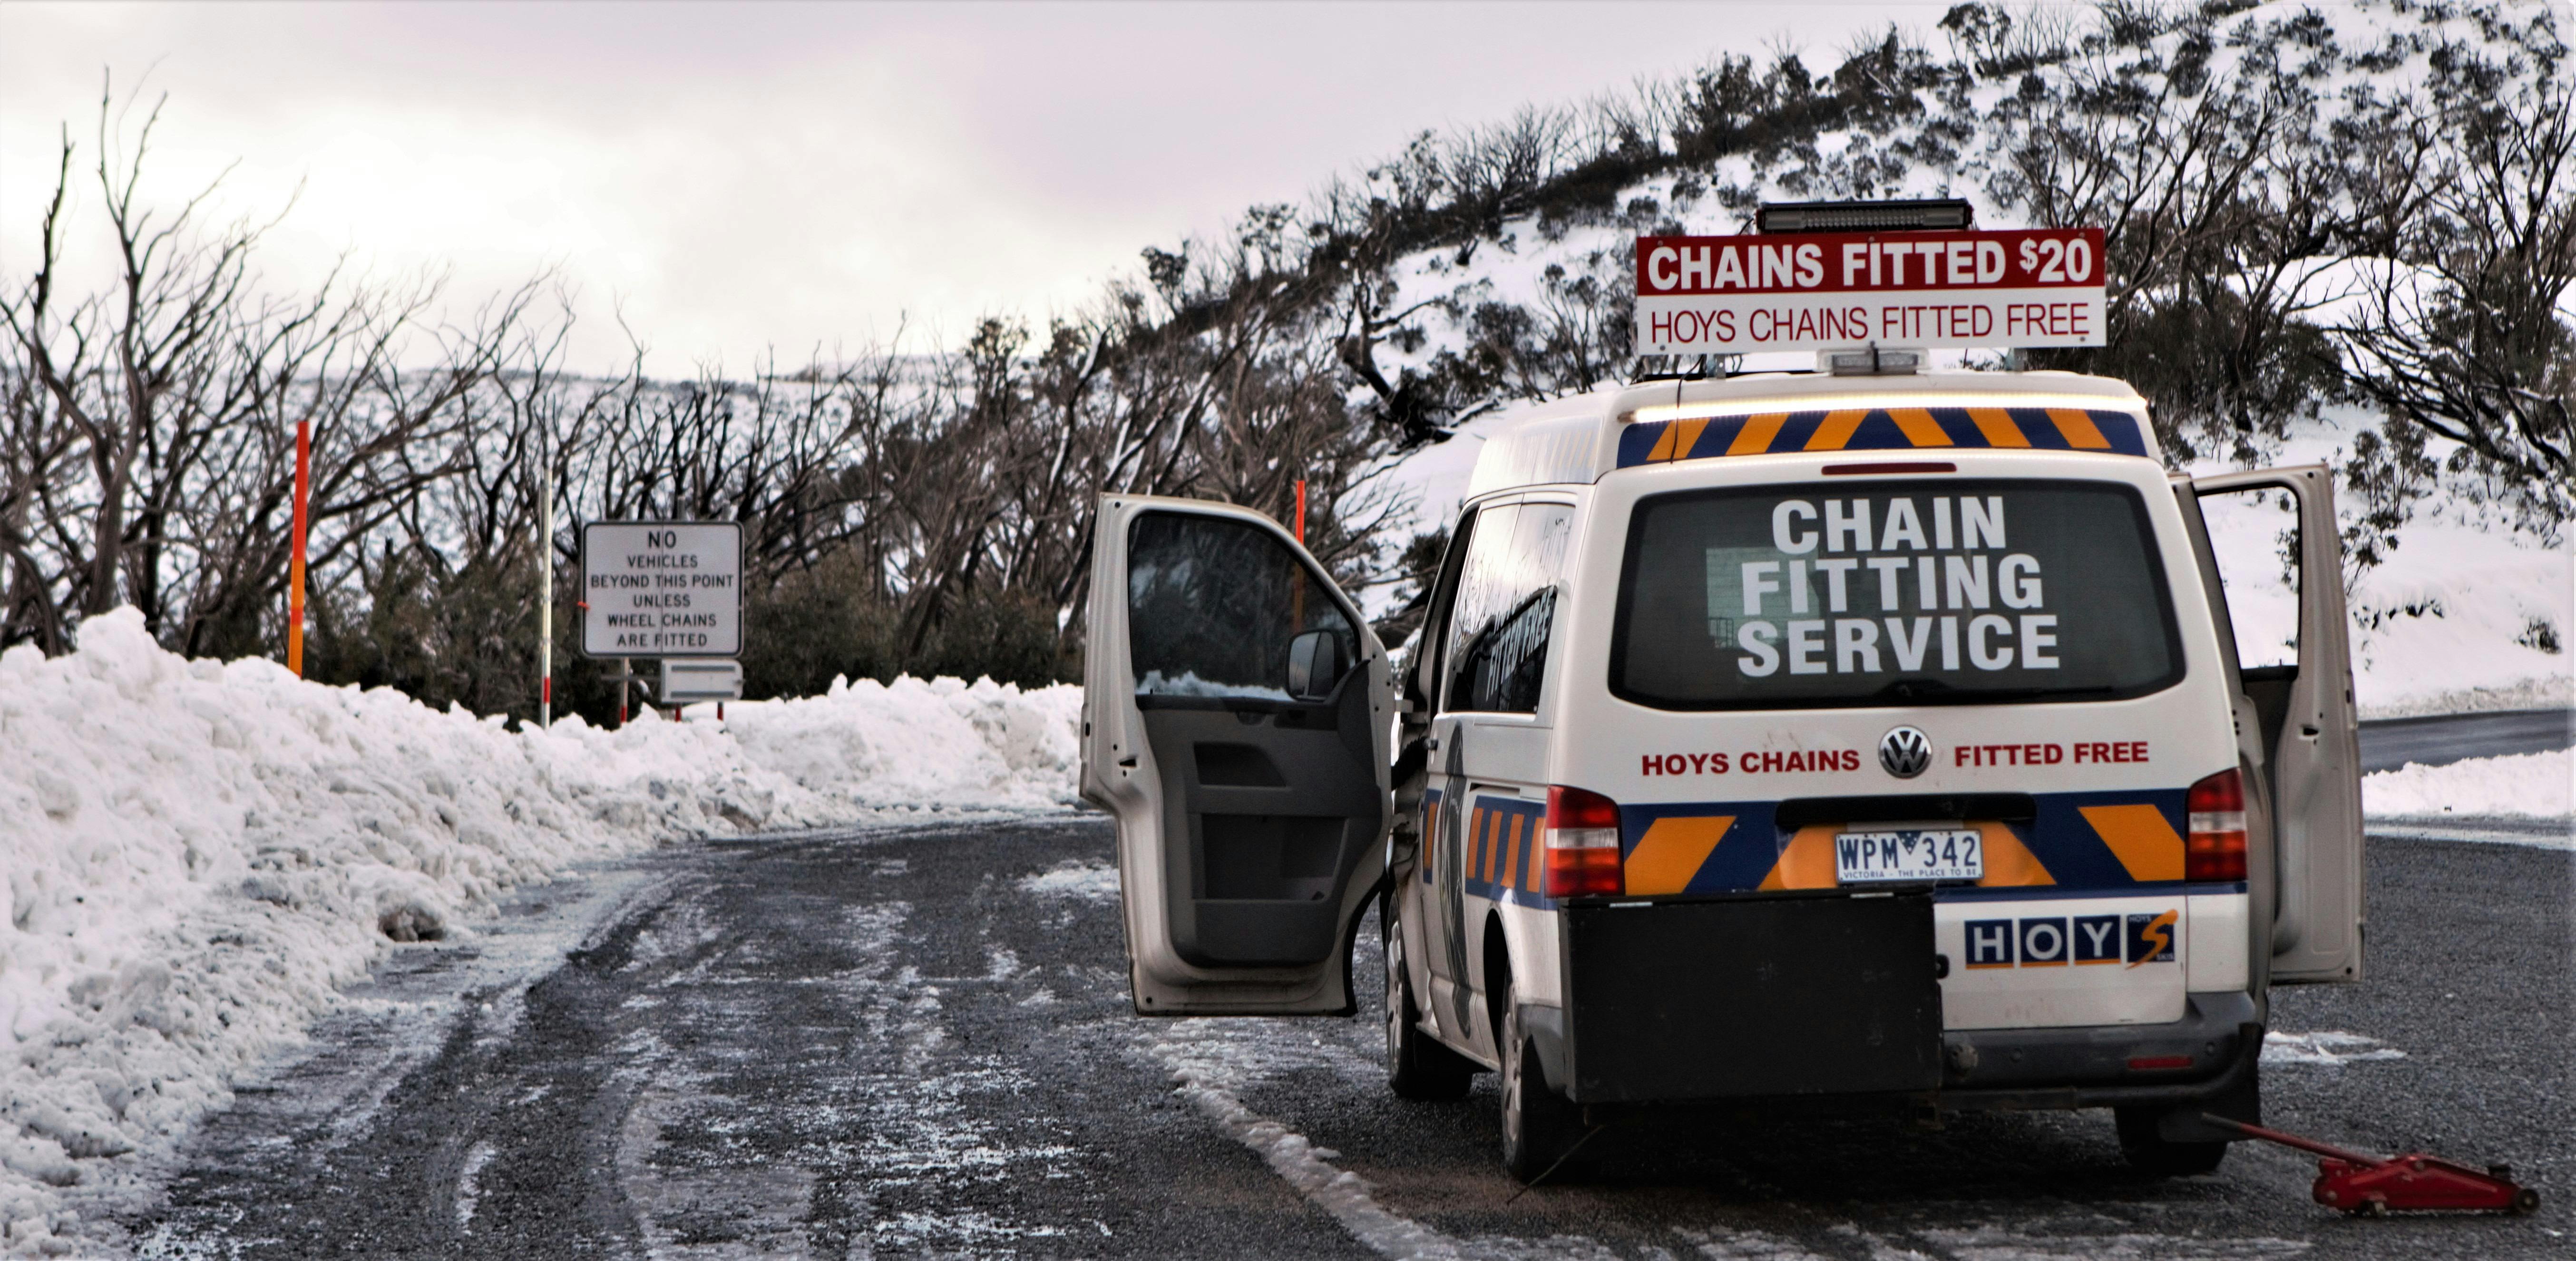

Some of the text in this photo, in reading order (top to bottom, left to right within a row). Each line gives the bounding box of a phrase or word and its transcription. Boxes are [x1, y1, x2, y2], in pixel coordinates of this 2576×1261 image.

[1648, 237, 2092, 291] CHAINS FITTED $20
[1652, 302, 2089, 344] HOYS CHAINS FITTED FREE
[648, 531, 676, 548] NO
[1773, 496, 2006, 554] CHAIN
[628, 555, 698, 568] VEHICLES
[591, 574, 733, 588] BEYOND THIS POINT
[1742, 553, 2043, 616] FITTING
[634, 594, 690, 608] UNLESS
[608, 614, 716, 627] WHEEL CHAINS
[618, 634, 707, 647] ARE FITTED
[1486, 620, 1522, 702] FITTED
[1521, 585, 1554, 663] FREE
[1737, 614, 2059, 678] SERVICE
[1642, 741, 2149, 776] HOYS CHAINS FITTED FREE
[1839, 836, 1976, 870] WPM 342
[1844, 870, 1884, 878] VICTORIA
[1919, 869, 1944, 877] PLACE
[1974, 909, 2178, 970] HOYS
